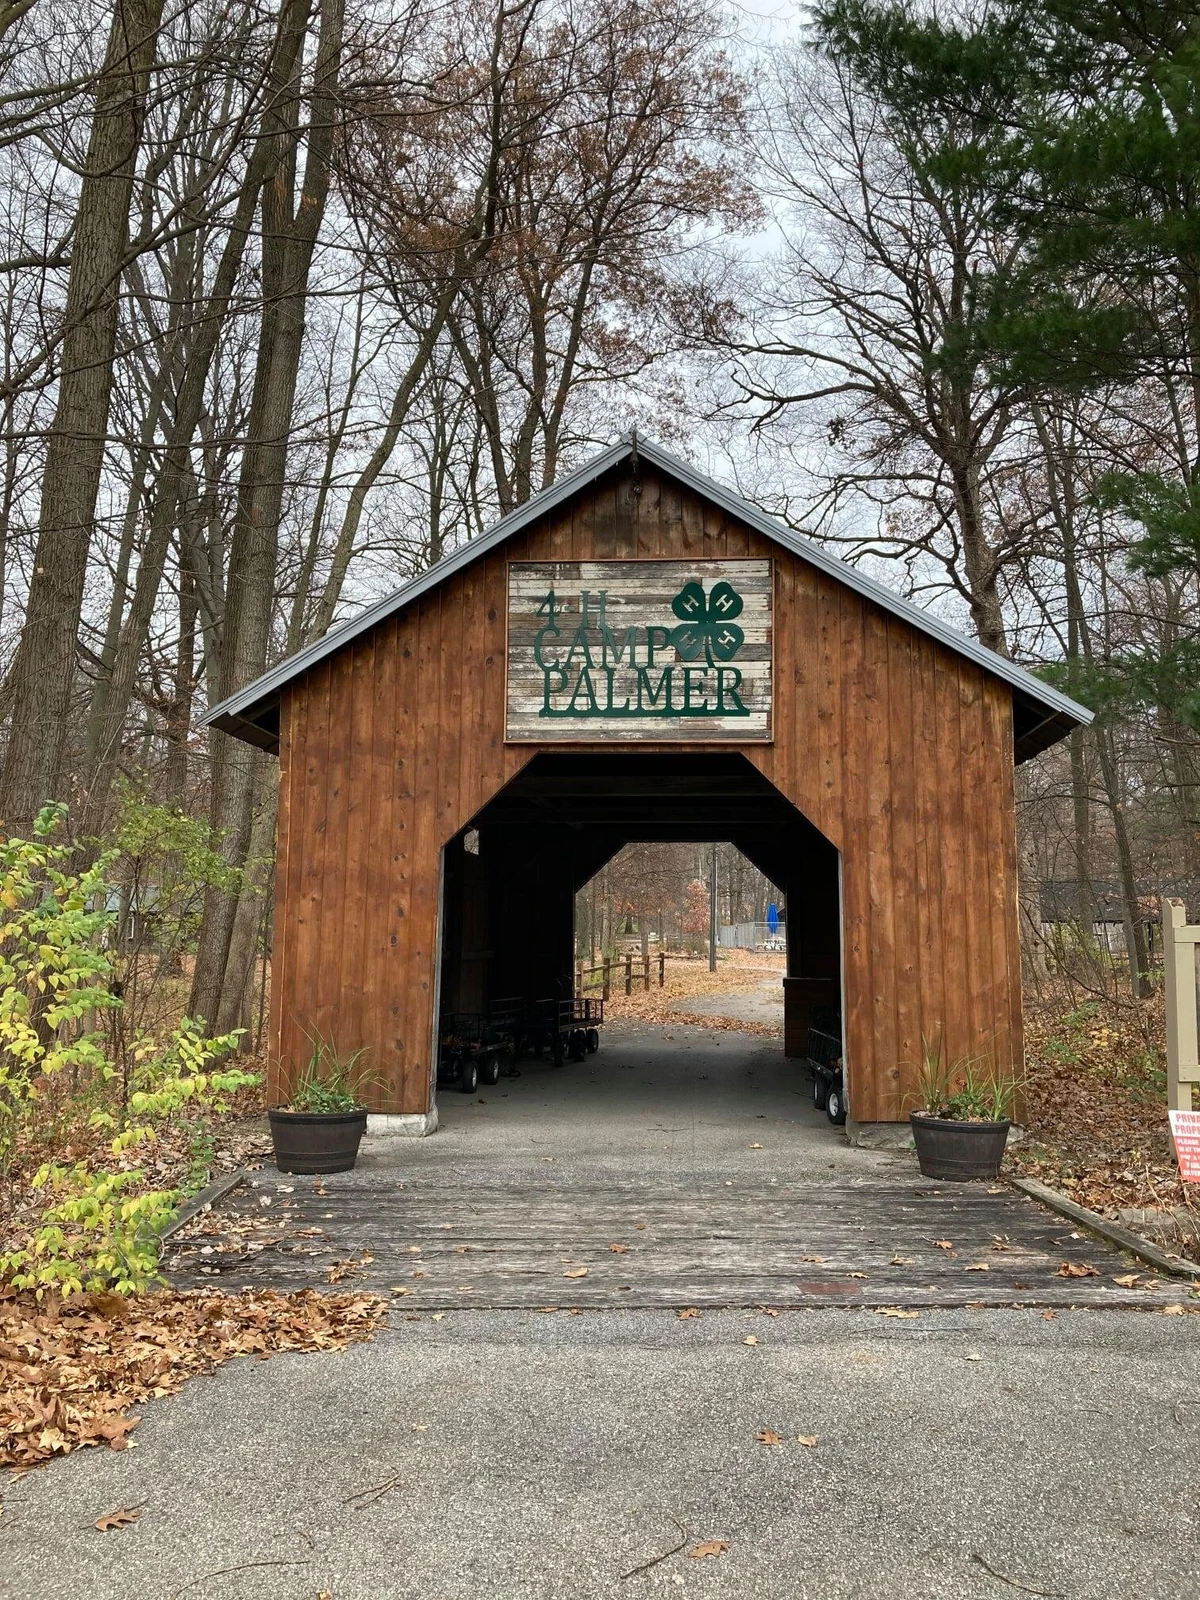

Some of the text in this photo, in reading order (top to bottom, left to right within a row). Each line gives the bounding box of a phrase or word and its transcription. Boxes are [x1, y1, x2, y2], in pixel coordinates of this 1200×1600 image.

[536, 590, 609, 629] 4-H
[535, 626, 674, 670] CAMP
[542, 667, 750, 712] PALMER
